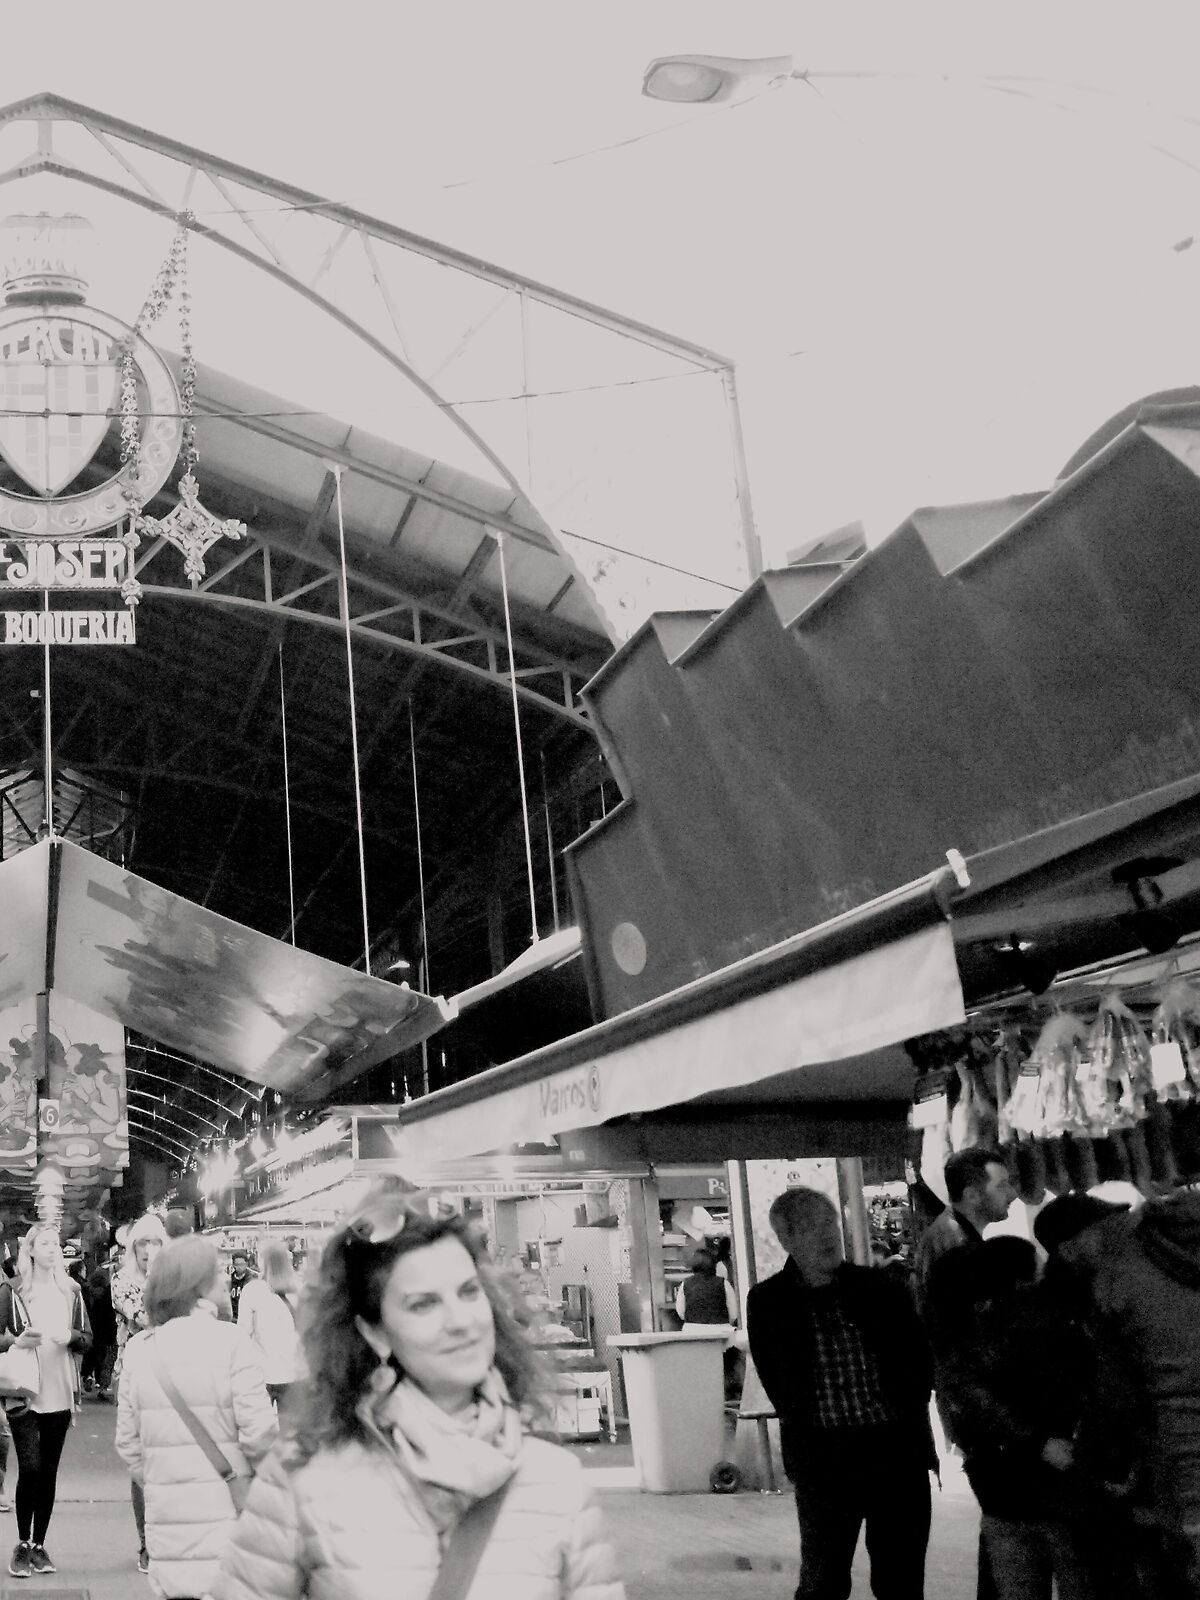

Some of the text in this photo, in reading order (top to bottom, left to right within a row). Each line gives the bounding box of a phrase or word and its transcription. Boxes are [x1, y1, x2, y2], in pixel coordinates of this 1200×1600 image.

[7, 542, 126, 588] JOSEP
[5, 611, 133, 644] BOQUERIA
[46, 1108, 55, 1124] 6
